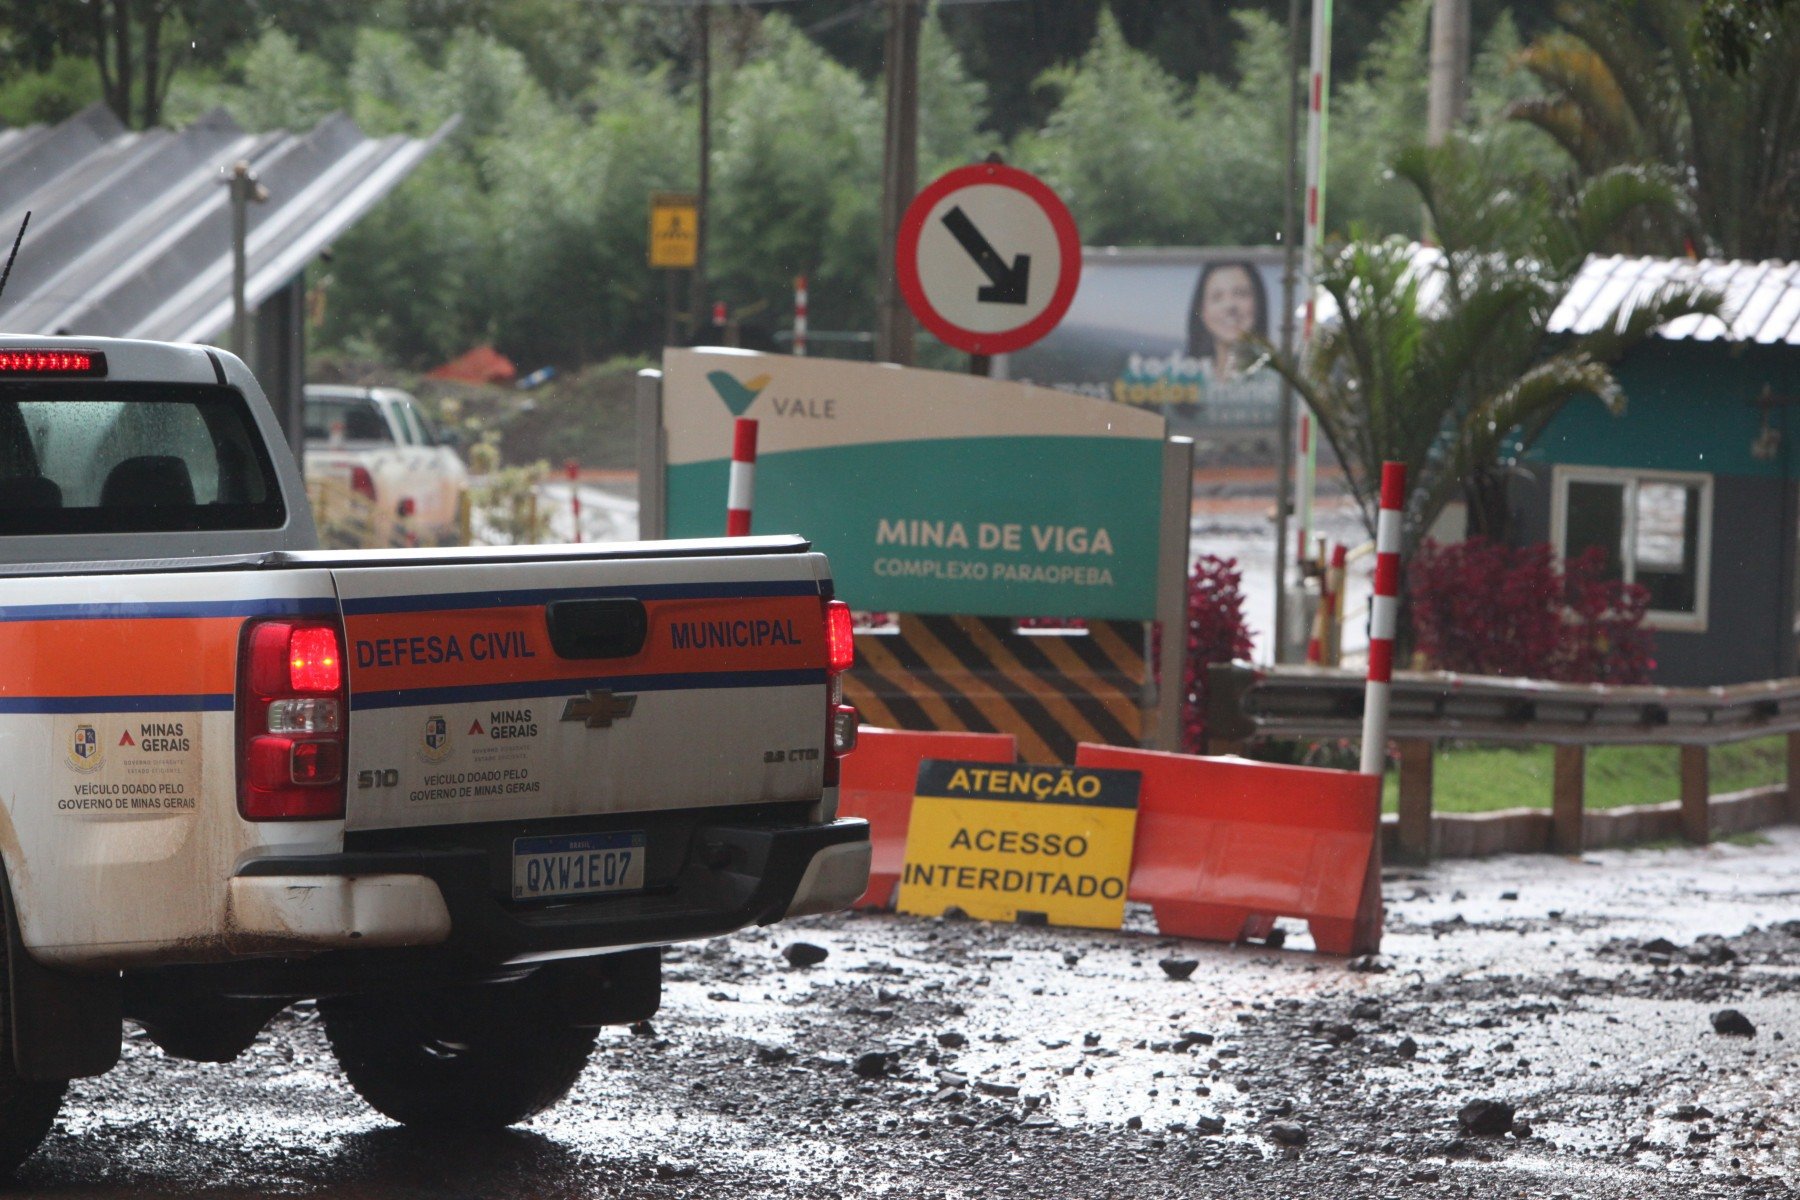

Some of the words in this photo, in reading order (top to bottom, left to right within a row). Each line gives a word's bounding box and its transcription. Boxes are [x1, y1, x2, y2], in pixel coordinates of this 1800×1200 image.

[772, 398, 836, 419] VALE
[876, 518, 969, 548] MINA
[978, 522, 1022, 551] DE
[1031, 525, 1113, 555] VIGA
[873, 557, 988, 580] COMPLEXO
[993, 563, 1114, 586] PARAOPEBA
[356, 635, 464, 668] DEFESA
[469, 631, 536, 661] CIVIL
[671, 619, 802, 649] MUNICIPAL
[490, 709, 532, 724] MINAS
[141, 724, 183, 736] MINAS
[490, 724, 538, 740] GERAIS
[142, 739, 190, 752] GERAIS
[357, 768, 399, 789] S10
[424, 772, 465, 786] VEÍCULO
[467, 770, 501, 783] DOADO
[503, 768, 528, 780] PELO
[947, 768, 1102, 800] ATENÇÃO
[74, 782, 120, 795] VEÍCULO
[122, 784, 157, 795] DOADO
[159, 783, 184, 794] PELO
[410, 788, 457, 802] GOVERNO
[459, 786, 472, 798] DE
[474, 784, 503, 796] MINAS
[506, 781, 540, 794] GERAIS
[58, 798, 113, 810] GOVERNO
[115, 798, 129, 809] DE
[131, 798, 161, 809] MINAS
[163, 797, 195, 809] GERAIS
[950, 828, 1088, 857] ACESSO
[527, 852, 632, 892] QXW1E07
[903, 863, 1124, 899] INTERDITADO
